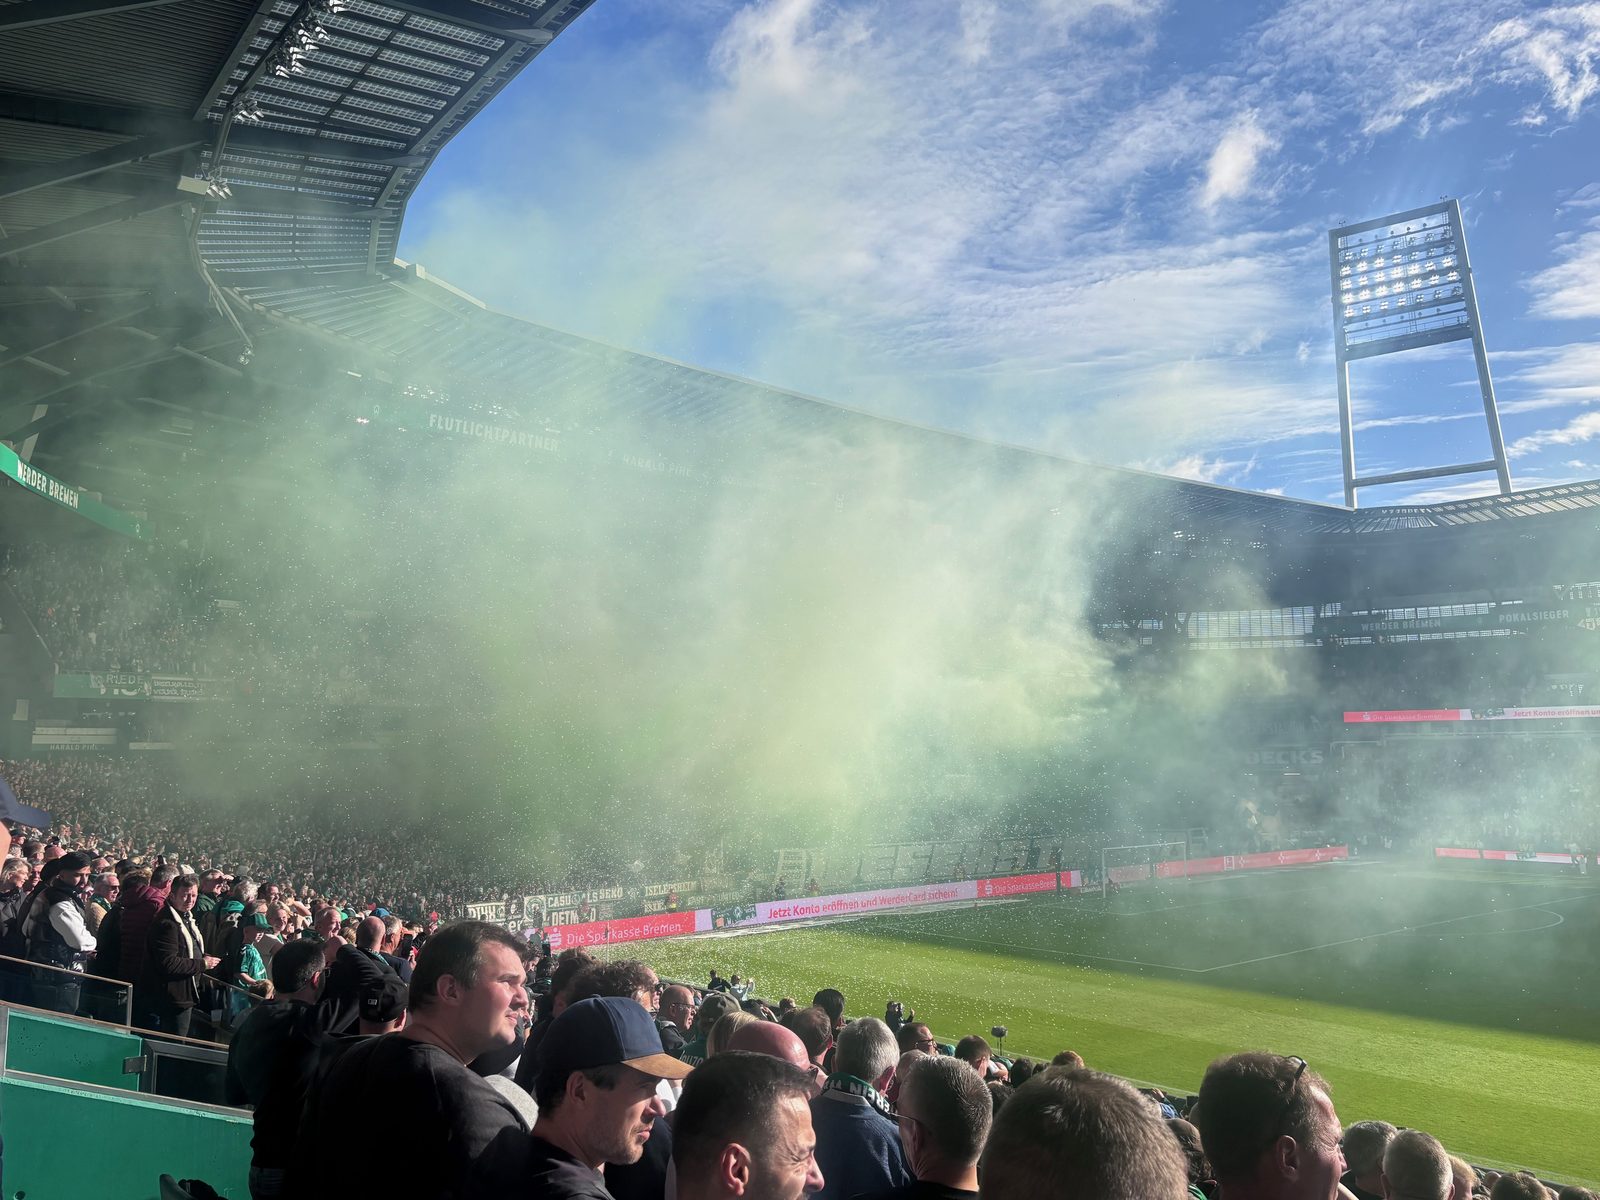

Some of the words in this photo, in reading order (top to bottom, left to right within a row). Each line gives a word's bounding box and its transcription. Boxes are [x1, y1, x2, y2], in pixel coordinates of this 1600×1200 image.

[429, 414, 560, 452] FLUTLICHTPARTNER
[17, 459, 47, 493] WERDER
[48, 480, 79, 509] BREMEN
[1361, 621, 1400, 632] WERDER
[1402, 617, 1441, 630] BREMEN
[1499, 609, 1568, 623] POKALSIEGER
[1534, 709, 1555, 717] Konto
[995, 884, 1006, 893] Die
[1007, 882, 1038, 893] Sparkasse
[768, 908, 791, 920] Jetzt
[793, 904, 820, 916] Konto
[822, 899, 859, 913] eröffnen
[861, 897, 877, 908] und
[879, 891, 927, 906] WerderCard
[552, 908, 596, 927] DETMD
[567, 932, 585, 945] Die
[588, 926, 640, 945] Sparkasse
[643, 923, 681, 936] Bremen
